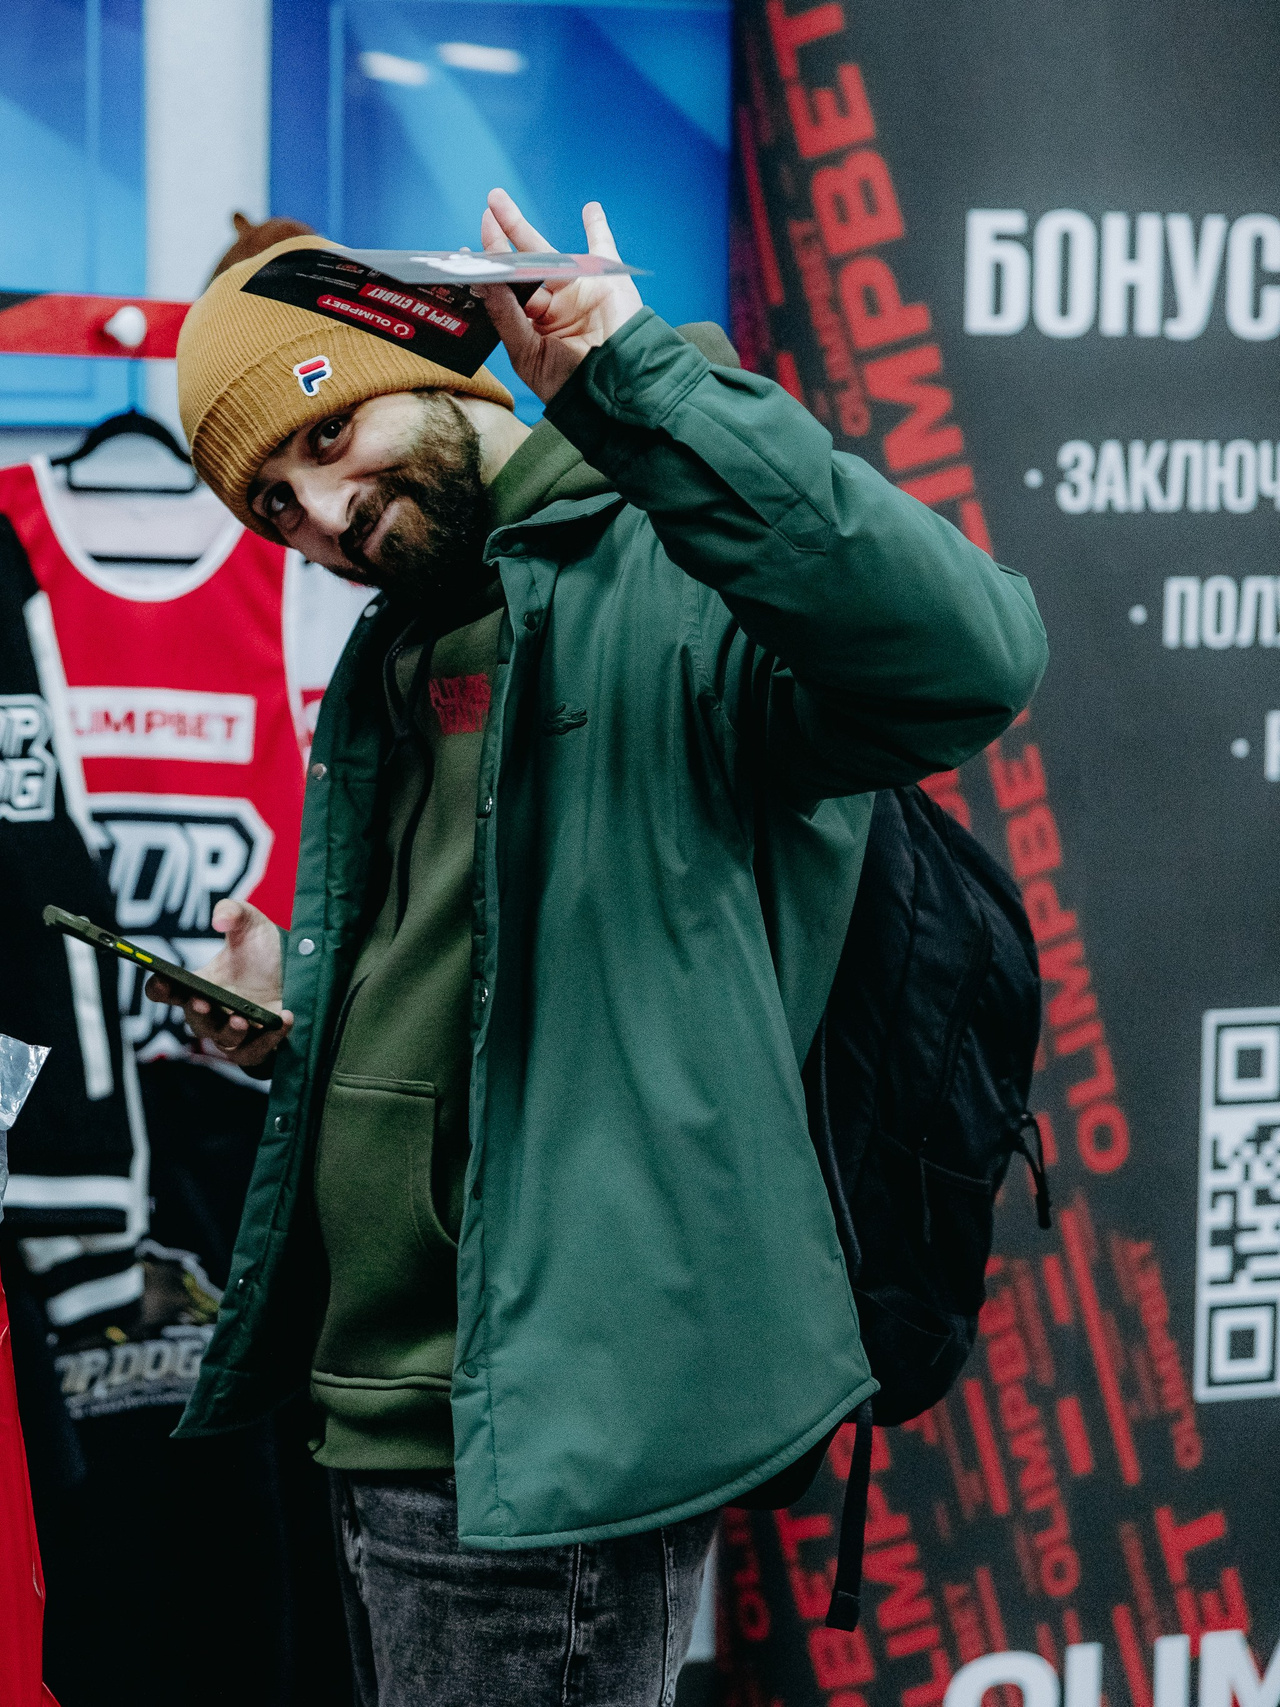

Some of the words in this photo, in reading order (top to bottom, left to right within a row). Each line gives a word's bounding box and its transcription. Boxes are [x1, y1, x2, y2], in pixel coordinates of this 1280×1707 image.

[321, 297, 393, 327] OLIMPBET
[367, 286, 413, 309] СТАВКУ
[767, 0, 996, 560] IMPBET
[965, 209, 1280, 341] БОНУС
[1161, 575, 1280, 650] ПОЛ
[102, 820, 251, 932] OP
[976, 1254, 1081, 1598] OLIMPBE
[773, 1508, 876, 1707] BET
